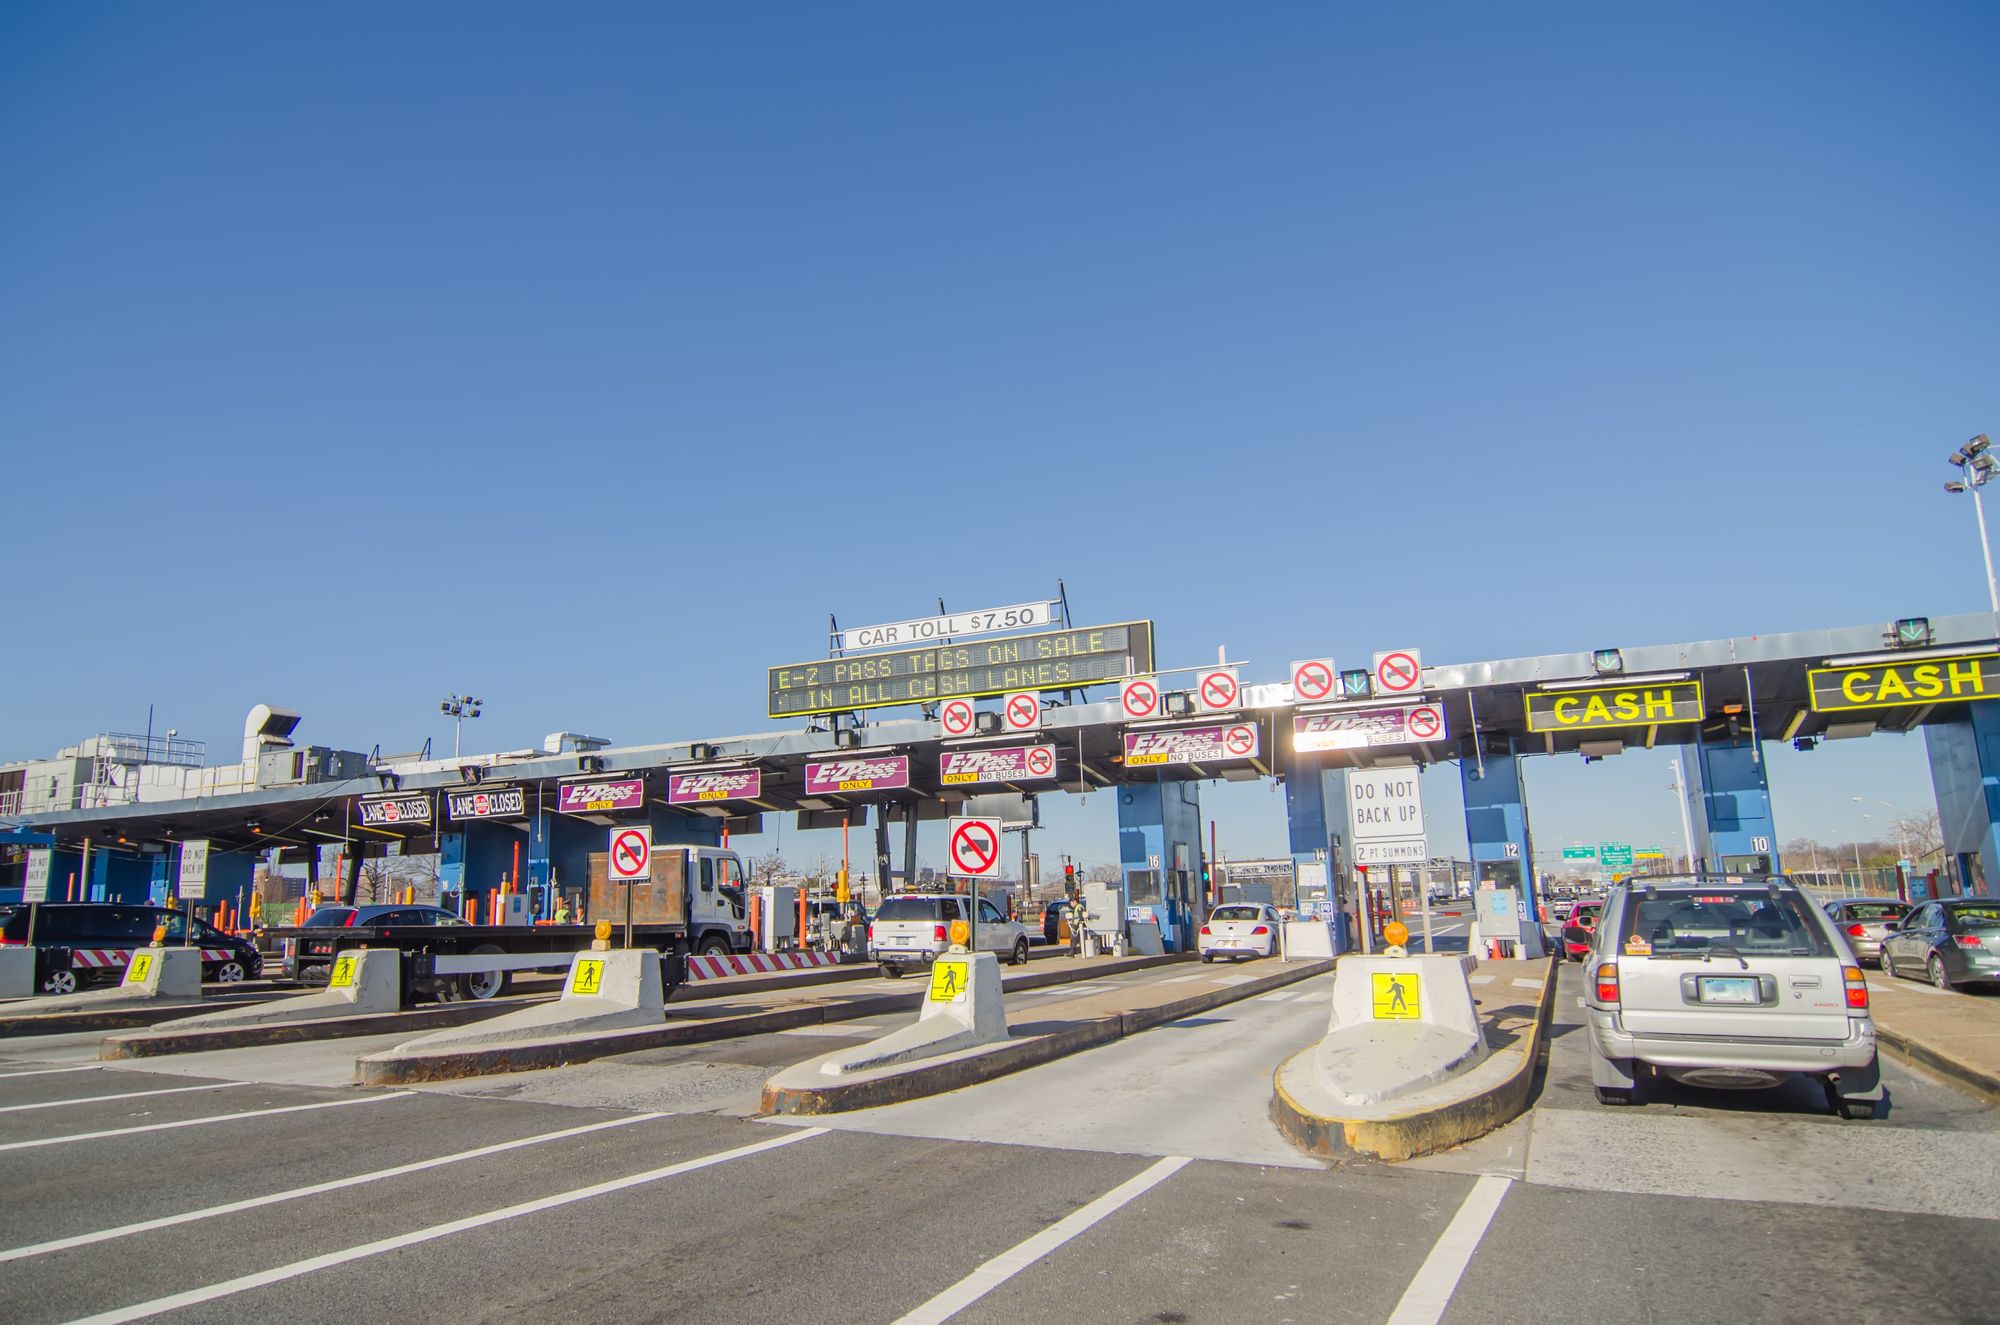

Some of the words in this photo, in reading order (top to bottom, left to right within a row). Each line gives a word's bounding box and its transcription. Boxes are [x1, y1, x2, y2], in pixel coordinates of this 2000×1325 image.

[858, 627, 898, 647] CAR
[909, 619, 959, 639] TOLL
[970, 607, 1035, 630] $7.50
[778, 668, 819, 689] E-Z
[835, 659, 891, 679] PASS
[909, 650, 969, 671] TAGS
[989, 643, 1018, 664] ON
[1038, 633, 1105, 658] SALE
[810, 688, 832, 708] IN
[850, 681, 891, 704] ALL
[989, 662, 1070, 687] LANES
[1841, 661, 1984, 702] CASH
[1554, 689, 1674, 725] CASH
[1367, 733, 1402, 743] BUSES
[1132, 754, 1162, 764] ONLY
[1170, 753, 1185, 761] NO
[1188, 750, 1220, 760] BUSES
[947, 773, 974, 783] ONLY
[980, 772, 992, 780] NO
[996, 770, 1024, 779] BUSES
[842, 780, 869, 789] ONLY
[1355, 784, 1375, 799] DO
[1385, 782, 1412, 797] NOT
[701, 791, 725, 799] ONLY
[451, 797, 475, 816] LANE
[489, 792, 522, 812] CLOSED
[589, 801, 610, 809] ONLY
[361, 802, 385, 822] LANE
[399, 800, 429, 820] CLOSED
[1357, 807, 1391, 823] BACK
[1399, 805, 1416, 821] UP
[1504, 844, 1518, 857] 12
[1752, 838, 1767, 851] 10
[183, 850, 192, 860] DO
[194, 849, 205, 859] NOT
[1314, 848, 1326, 861] 14
[1358, 848, 1365, 860] 2
[1370, 848, 1378, 858] PT
[1383, 846, 1424, 858] SUMMONS
[29, 858, 37, 867] DO
[38, 857, 48, 866] NOT
[1149, 855, 1159, 867] 16
[182, 864, 196, 875] BACK
[196, 863, 204, 873] UP
